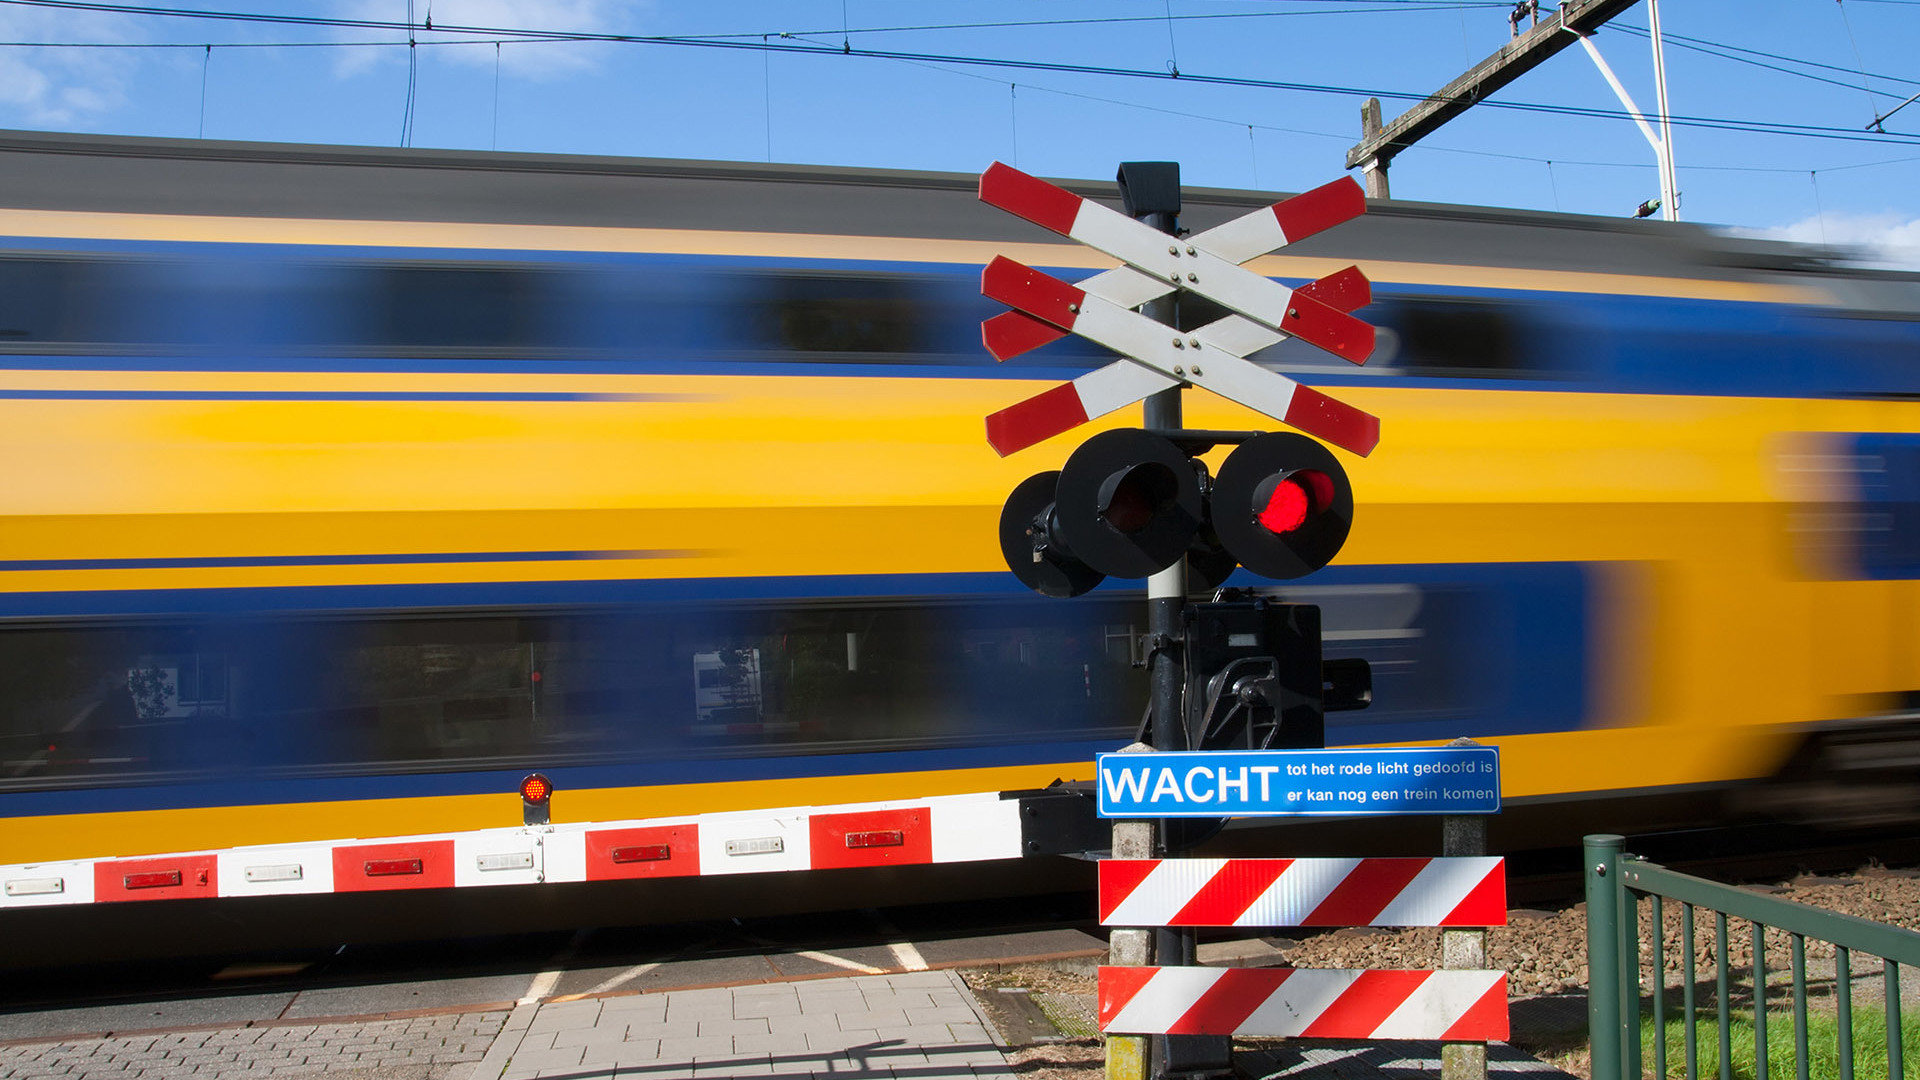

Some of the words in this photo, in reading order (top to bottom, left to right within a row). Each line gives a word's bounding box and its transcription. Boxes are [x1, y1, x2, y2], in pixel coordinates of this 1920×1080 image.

[1286, 763, 1308, 776] tot
[1311, 762, 1335, 776] het
[1339, 762, 1373, 775] rode
[1377, 761, 1409, 775] licht
[1413, 761, 1475, 777] gedoofd
[1480, 760, 1494, 773] is
[1102, 765, 1279, 803] WACHT
[1286, 791, 1303, 802] er
[1306, 788, 1334, 802] kan
[1338, 790, 1367, 804] nog
[1371, 790, 1399, 801] een
[1403, 788, 1438, 800] trein
[1443, 787, 1494, 800] komen
